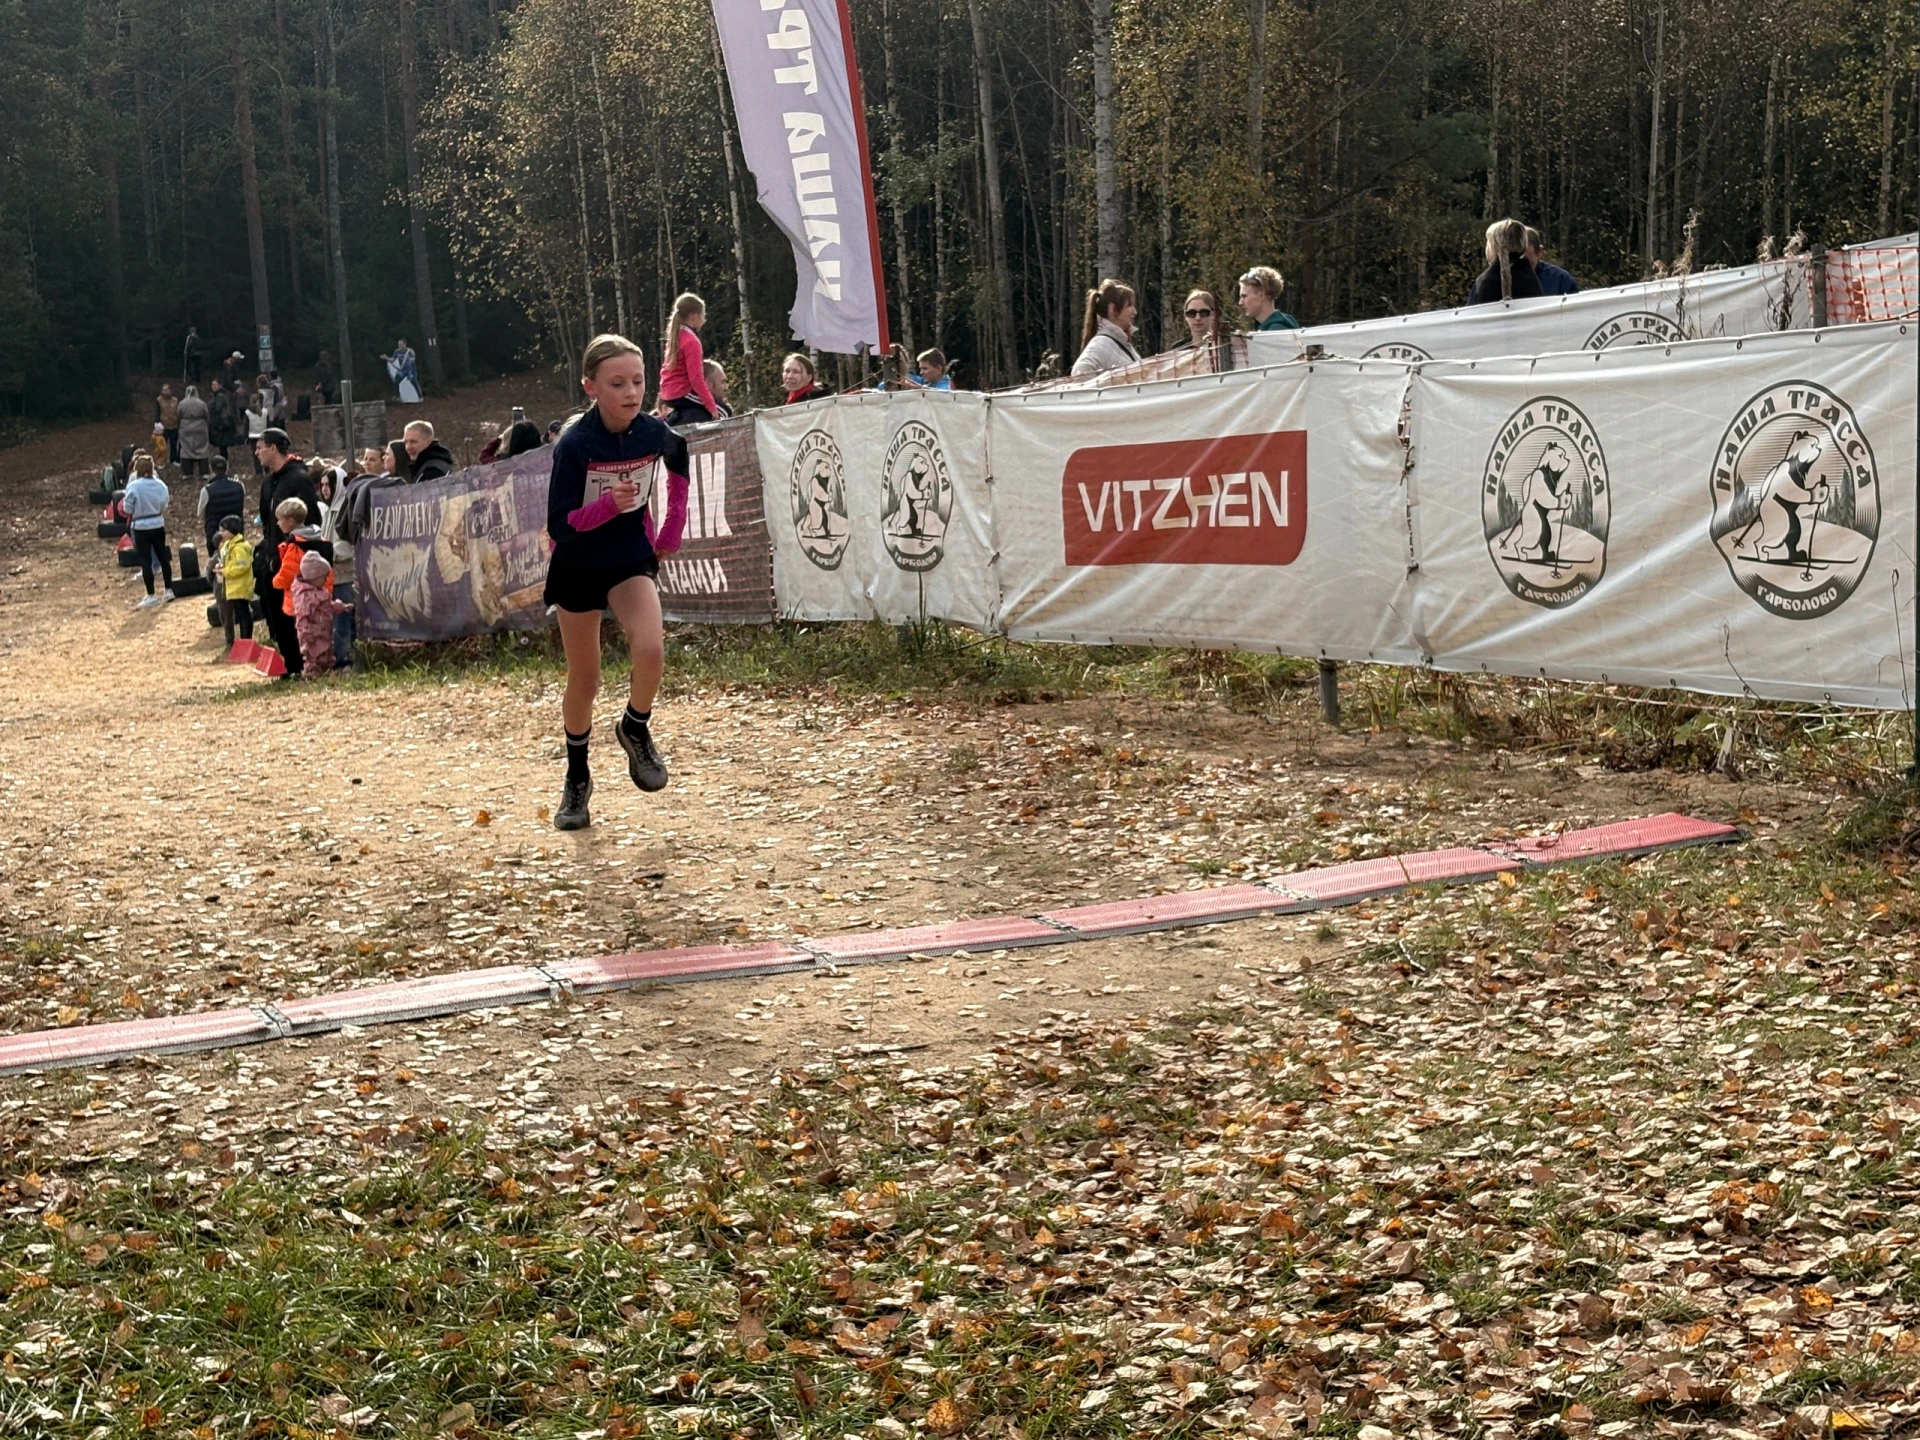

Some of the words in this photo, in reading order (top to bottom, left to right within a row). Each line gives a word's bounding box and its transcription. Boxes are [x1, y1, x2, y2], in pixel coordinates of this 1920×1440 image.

[882, 431, 907, 490] НАША
[911, 426, 950, 492] ТРАССА
[1486, 410, 1534, 496] НАША
[1542, 405, 1605, 497] ТРАССА
[1715, 396, 1776, 492] НАША
[1787, 390, 1872, 489] ТРАССА
[1077, 470, 1289, 532] VITZHEN
[664, 558, 729, 595] НАМИ
[1516, 582, 1587, 603] ГАРБОЛОВО
[1757, 584, 1837, 611] ГАРБОЛОВО
